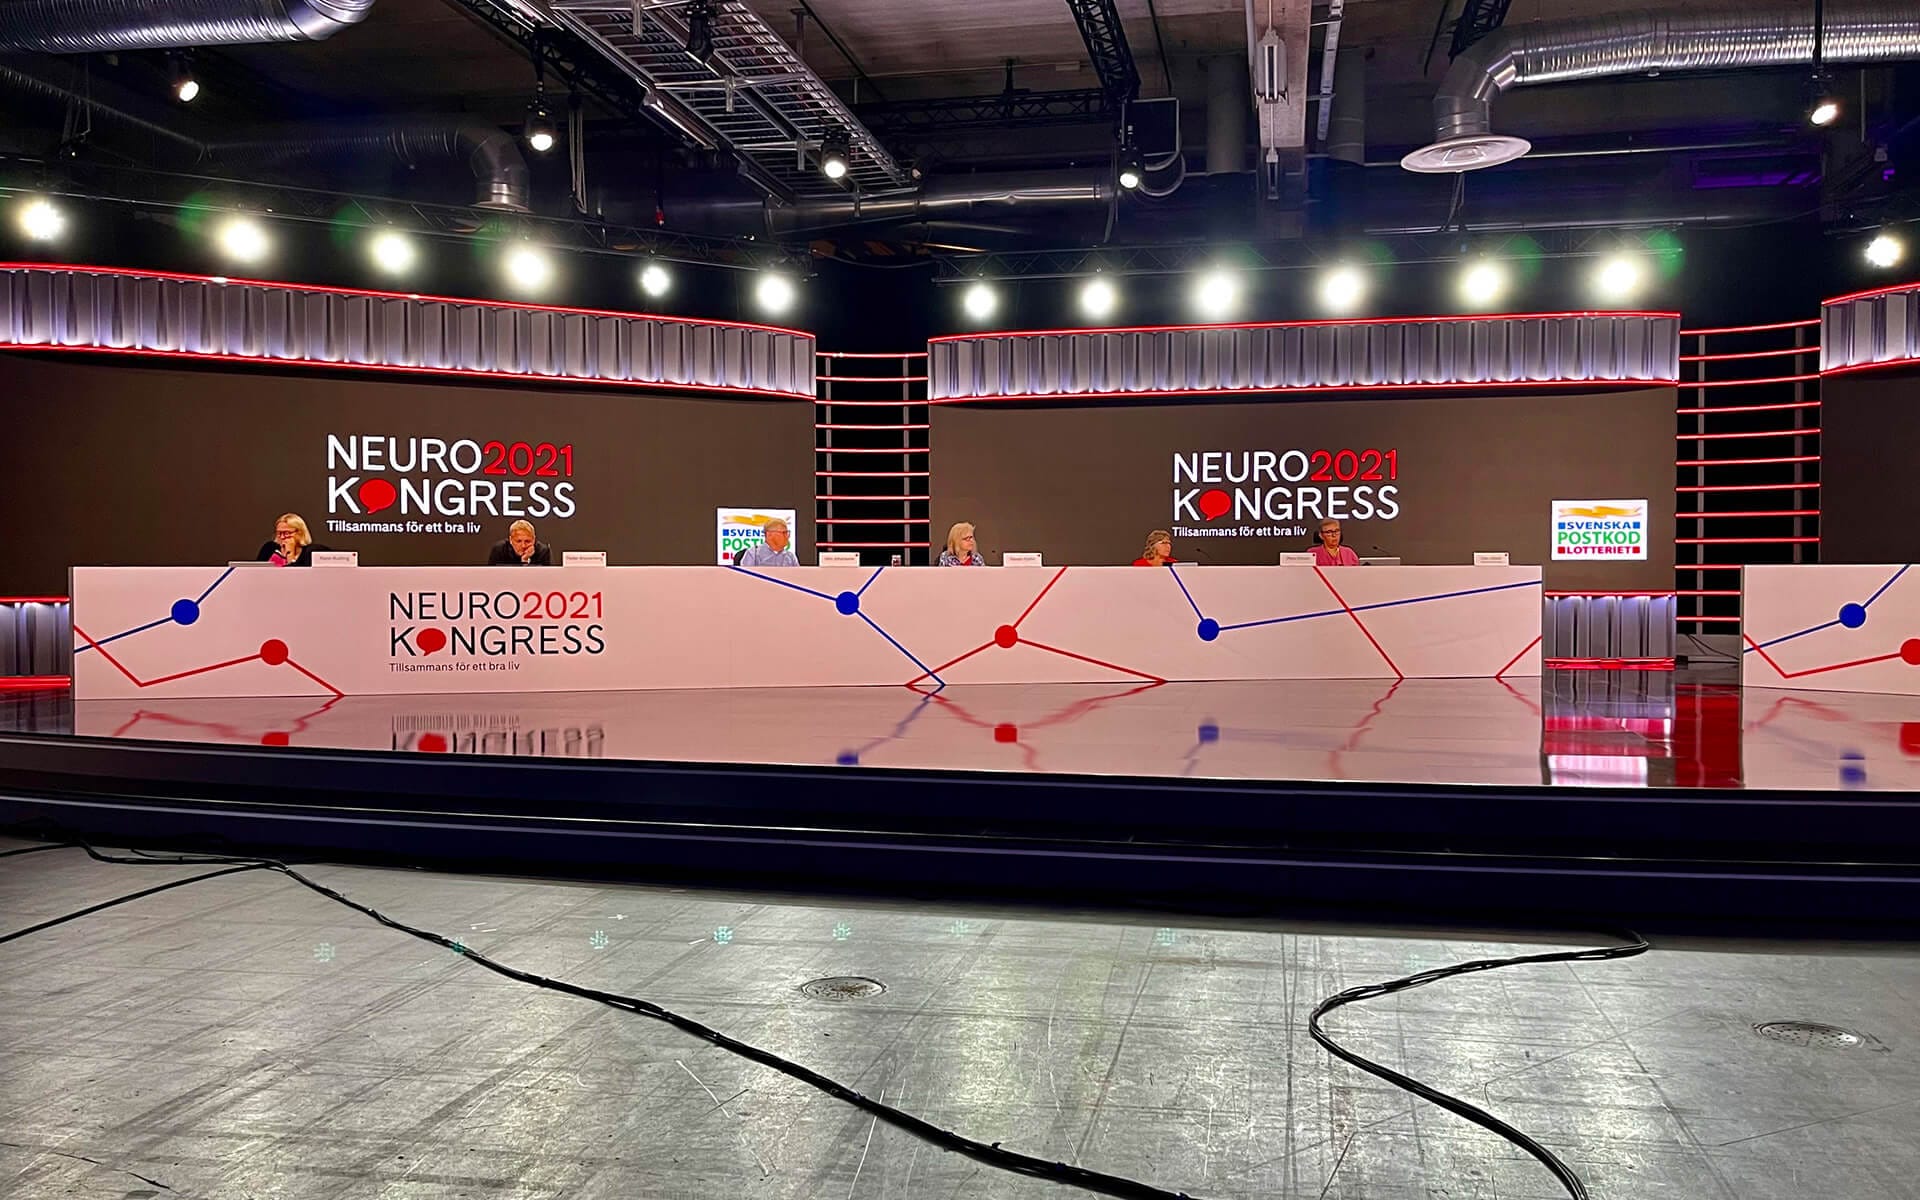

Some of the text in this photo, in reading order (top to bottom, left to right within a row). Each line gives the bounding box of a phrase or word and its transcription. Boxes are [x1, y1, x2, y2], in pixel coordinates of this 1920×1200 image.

[326, 520, 481, 533] Tillsammans för ett bra liv
[1567, 521, 1631, 530] SVENSKA
[1172, 526, 1307, 537] Tillsammans för ett bra liv
[1558, 531, 1641, 545] POSTKOD
[1566, 546, 1631, 554] LOTTERIET
[390, 661, 520, 672] Tillsammans för ett bra liv
